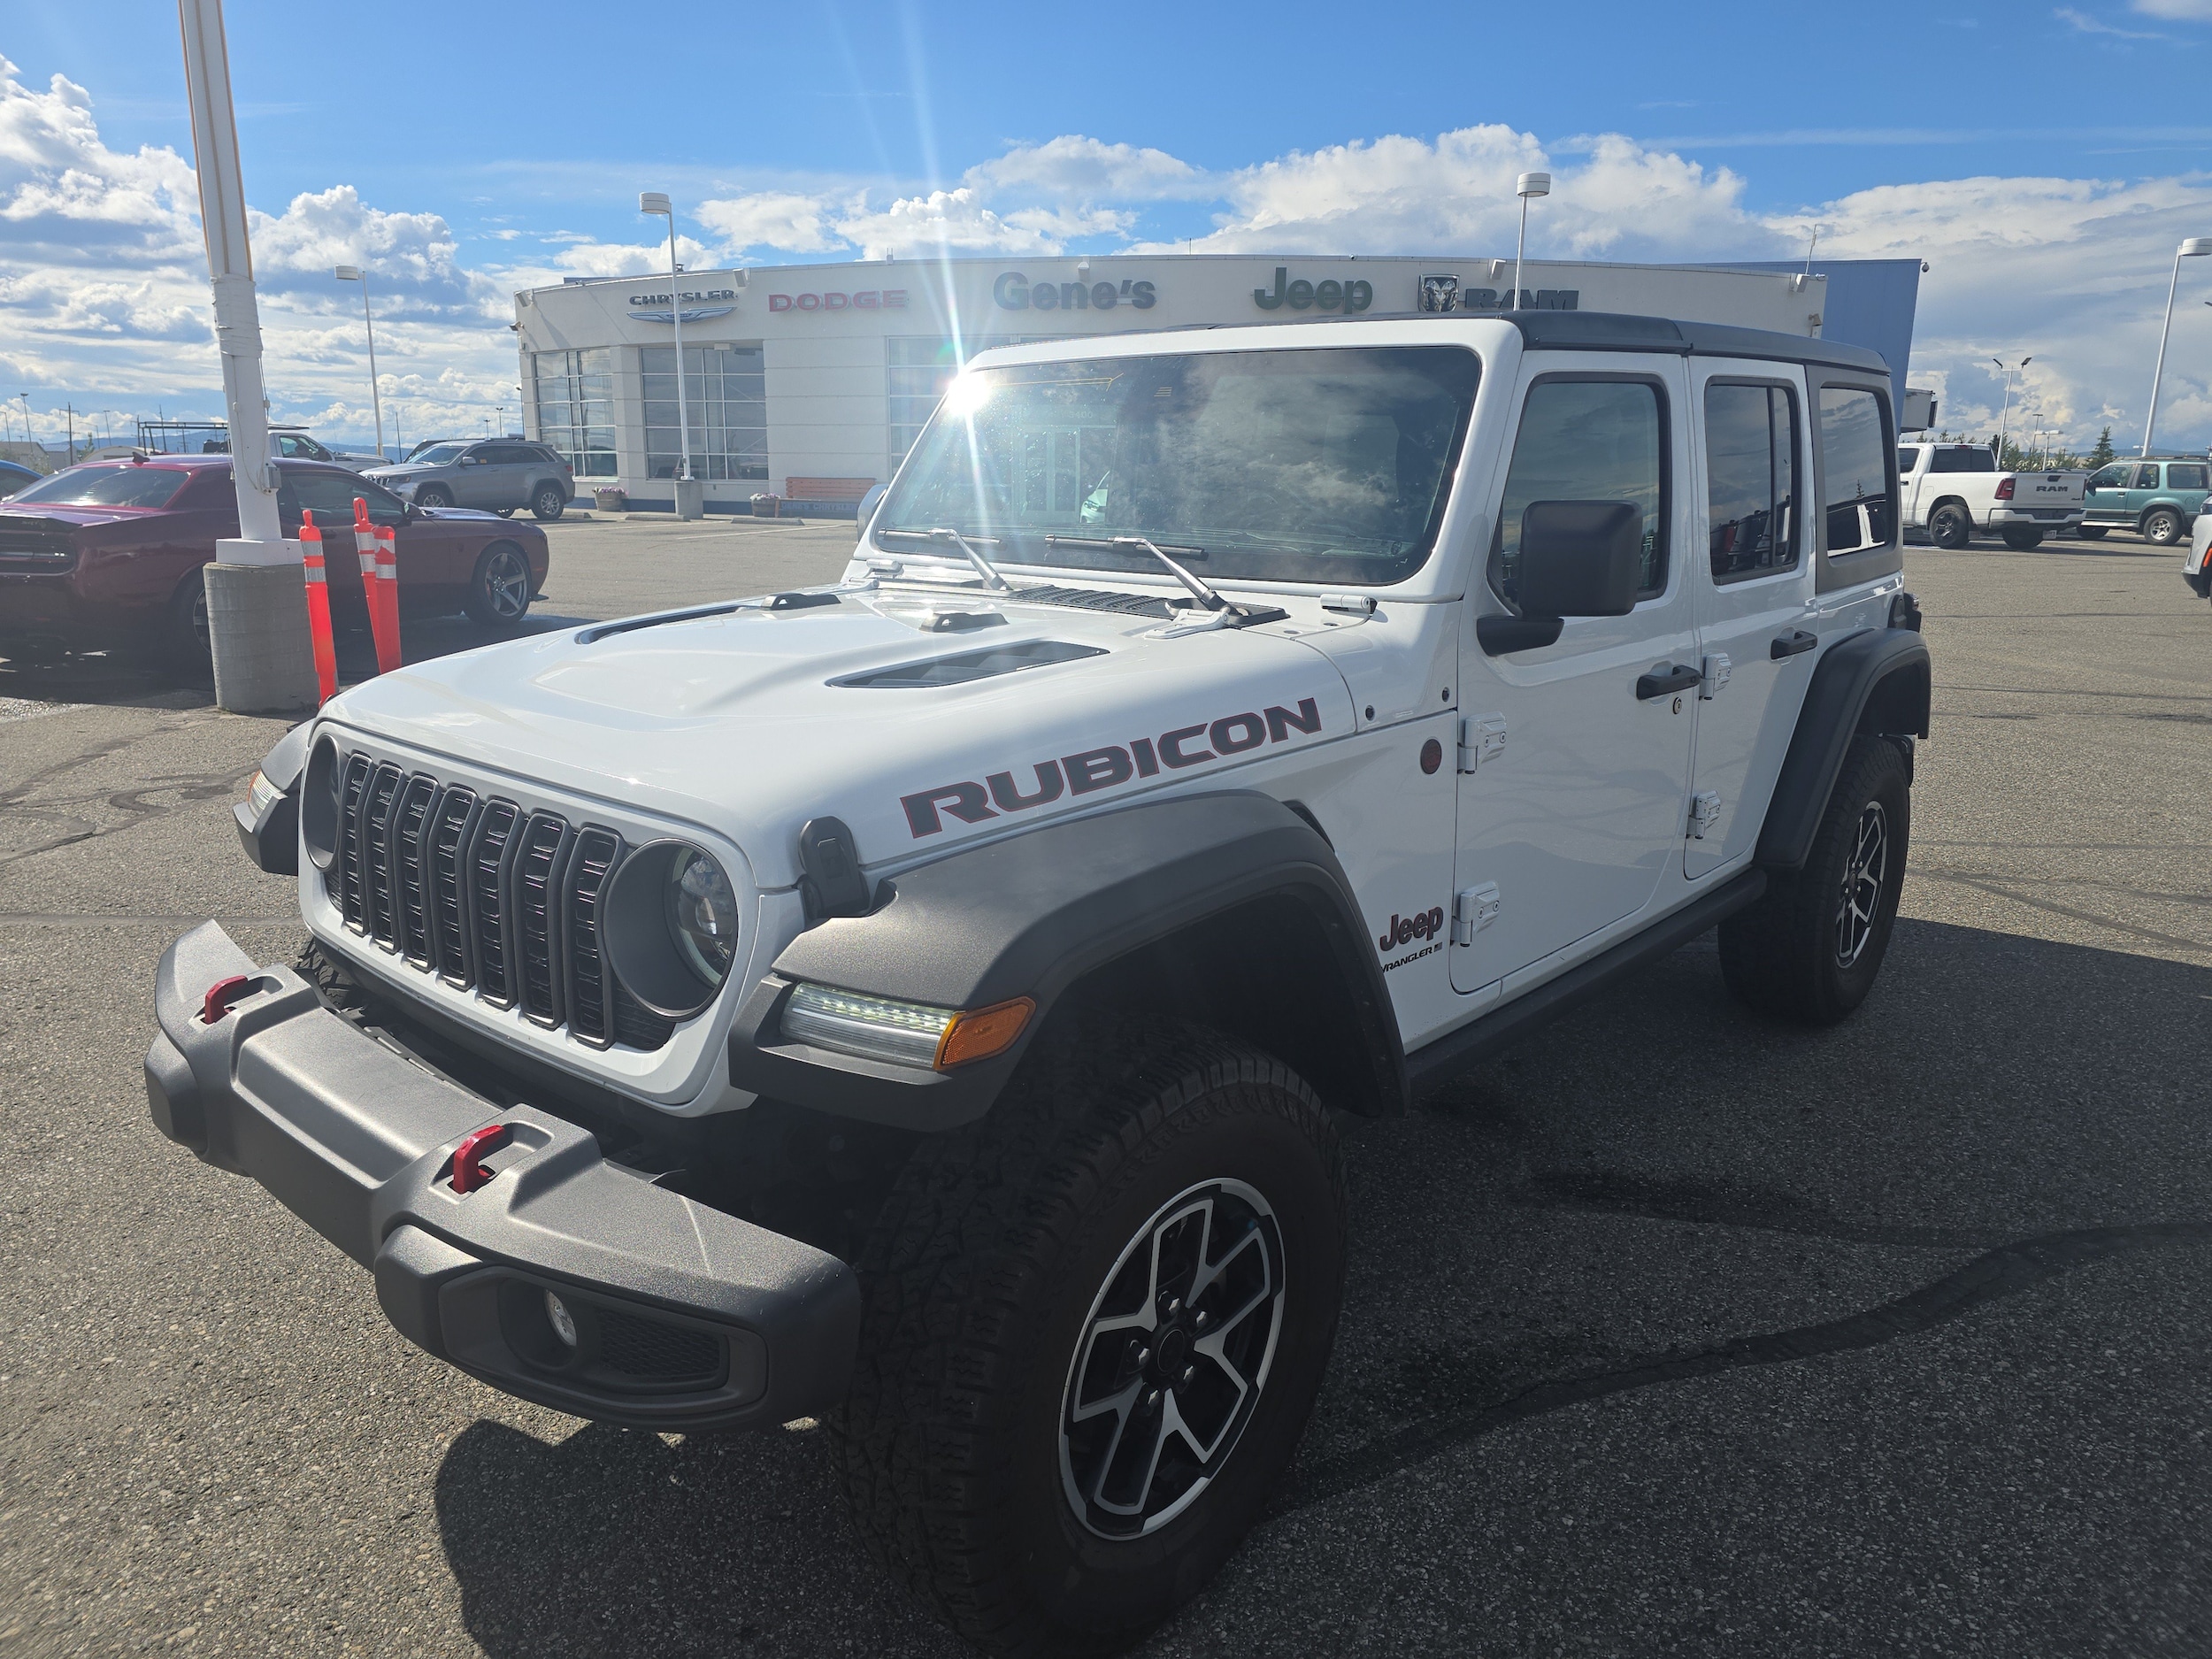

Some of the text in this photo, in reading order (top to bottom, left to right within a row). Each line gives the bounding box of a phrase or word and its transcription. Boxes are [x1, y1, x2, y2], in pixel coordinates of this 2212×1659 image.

[769, 289, 908, 311] DODGE
[993, 272, 1156, 310] Gene's
[1254, 267, 1372, 313] Jeep
[1465, 288, 1579, 310] RAM
[900, 697, 1322, 839] RUBICON
[1380, 906, 1443, 951] Jeep
